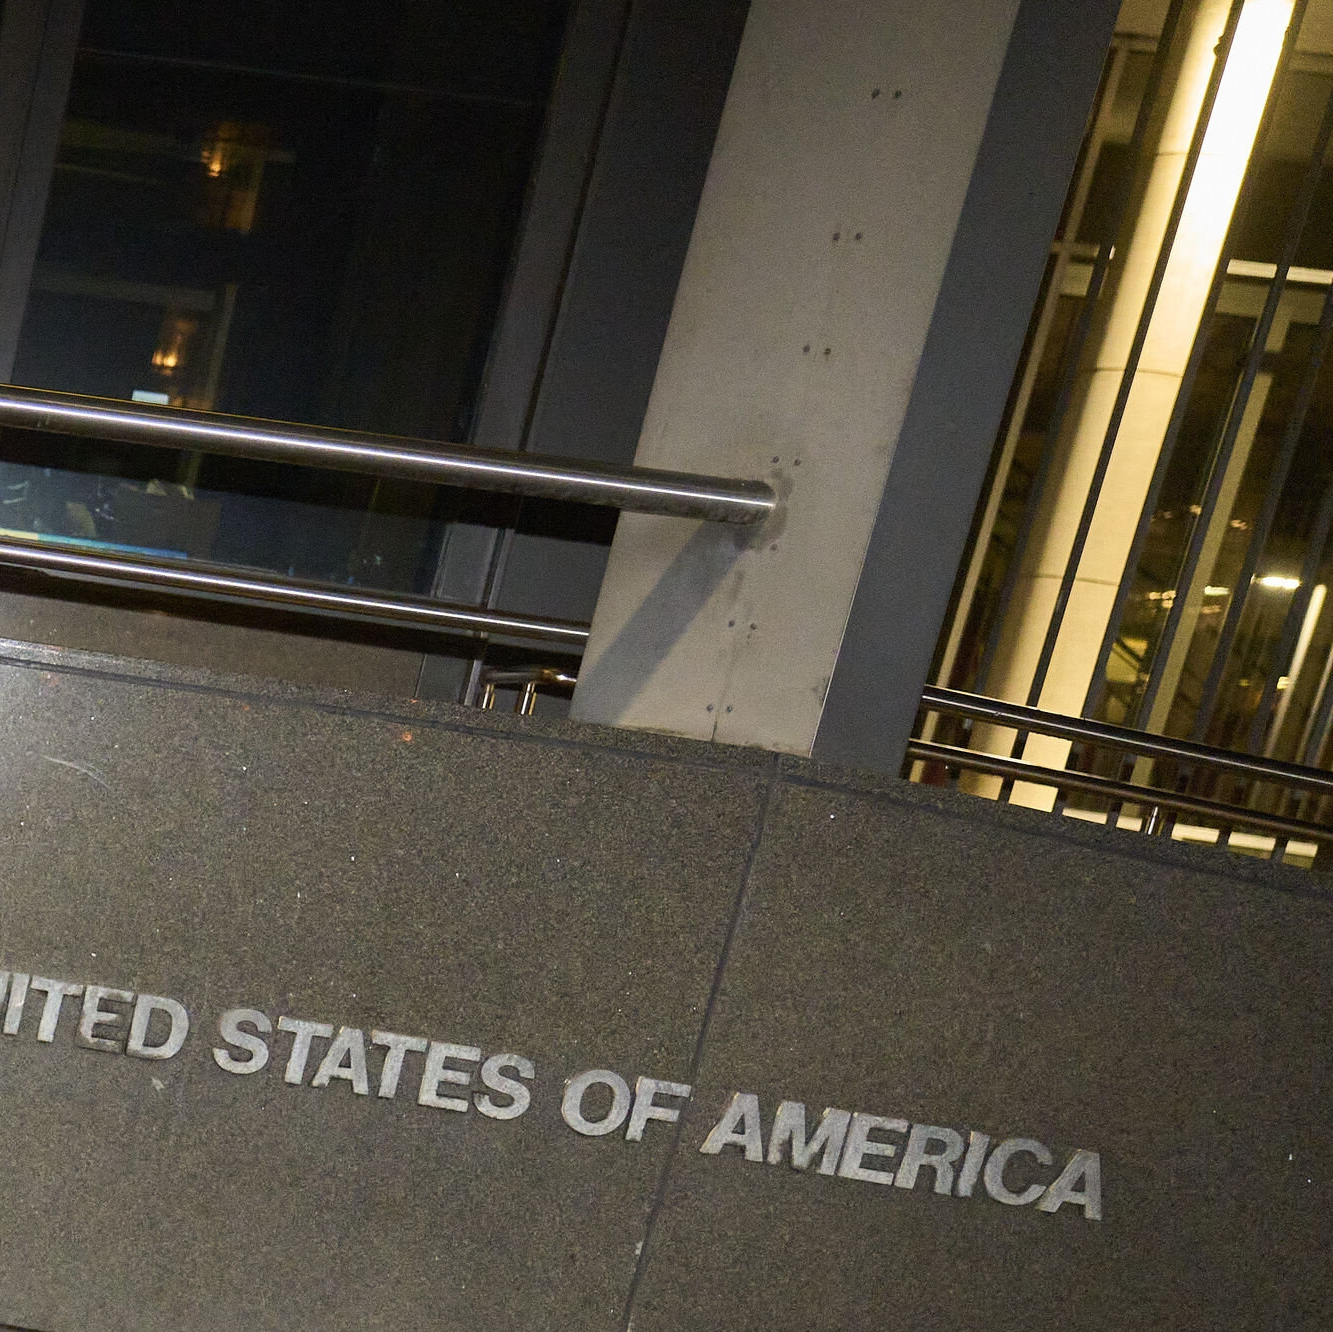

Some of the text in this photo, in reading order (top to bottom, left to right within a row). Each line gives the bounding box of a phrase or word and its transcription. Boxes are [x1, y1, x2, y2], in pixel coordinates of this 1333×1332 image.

[212, 1008, 535, 1121] STATES
[561, 1069, 692, 1142] OF
[699, 1092, 1103, 1221] AMERICA
